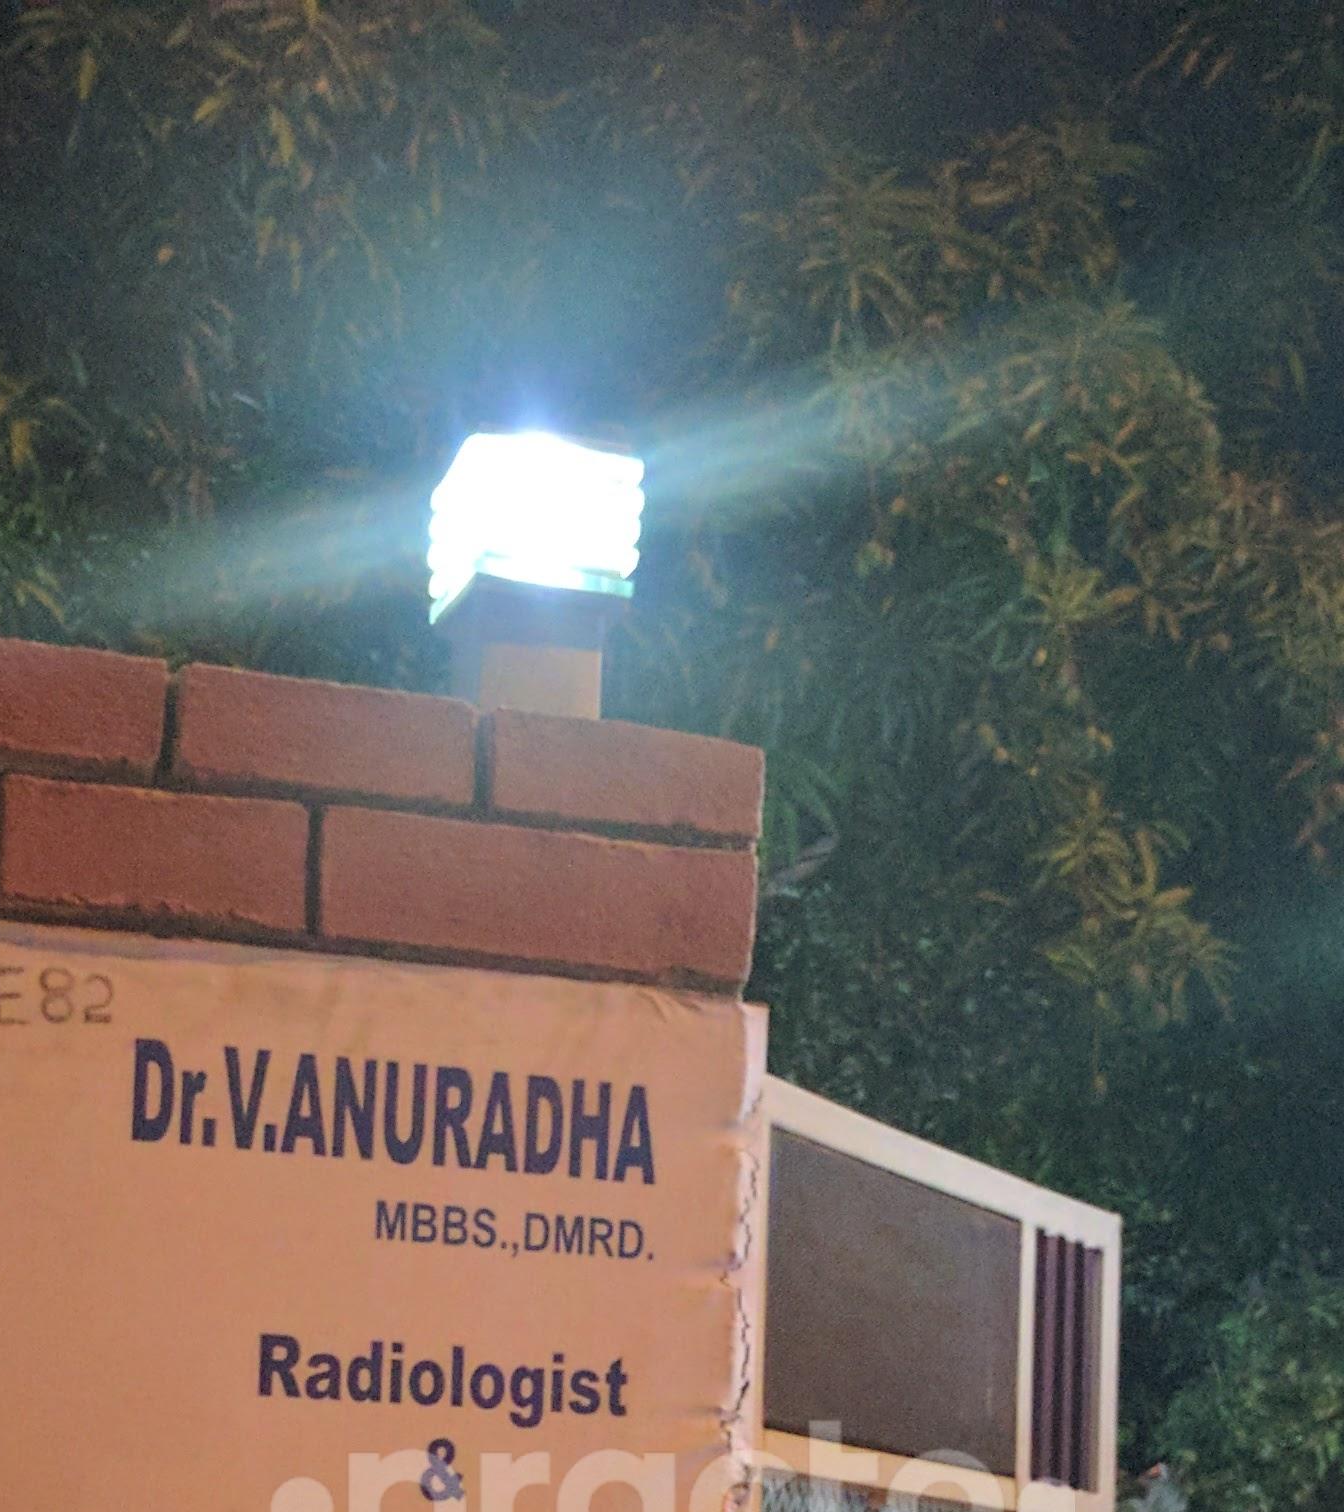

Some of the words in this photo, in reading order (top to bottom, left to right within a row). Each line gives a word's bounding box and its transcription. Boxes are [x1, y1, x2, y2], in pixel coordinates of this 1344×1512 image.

[131, 1038, 656, 1186] Dr.V.ANURADHA
[375, 1201, 656, 1262] MBBS.,DMRD.
[258, 1334, 629, 1429] Radiologist
[419, 1438, 466, 1503] &
